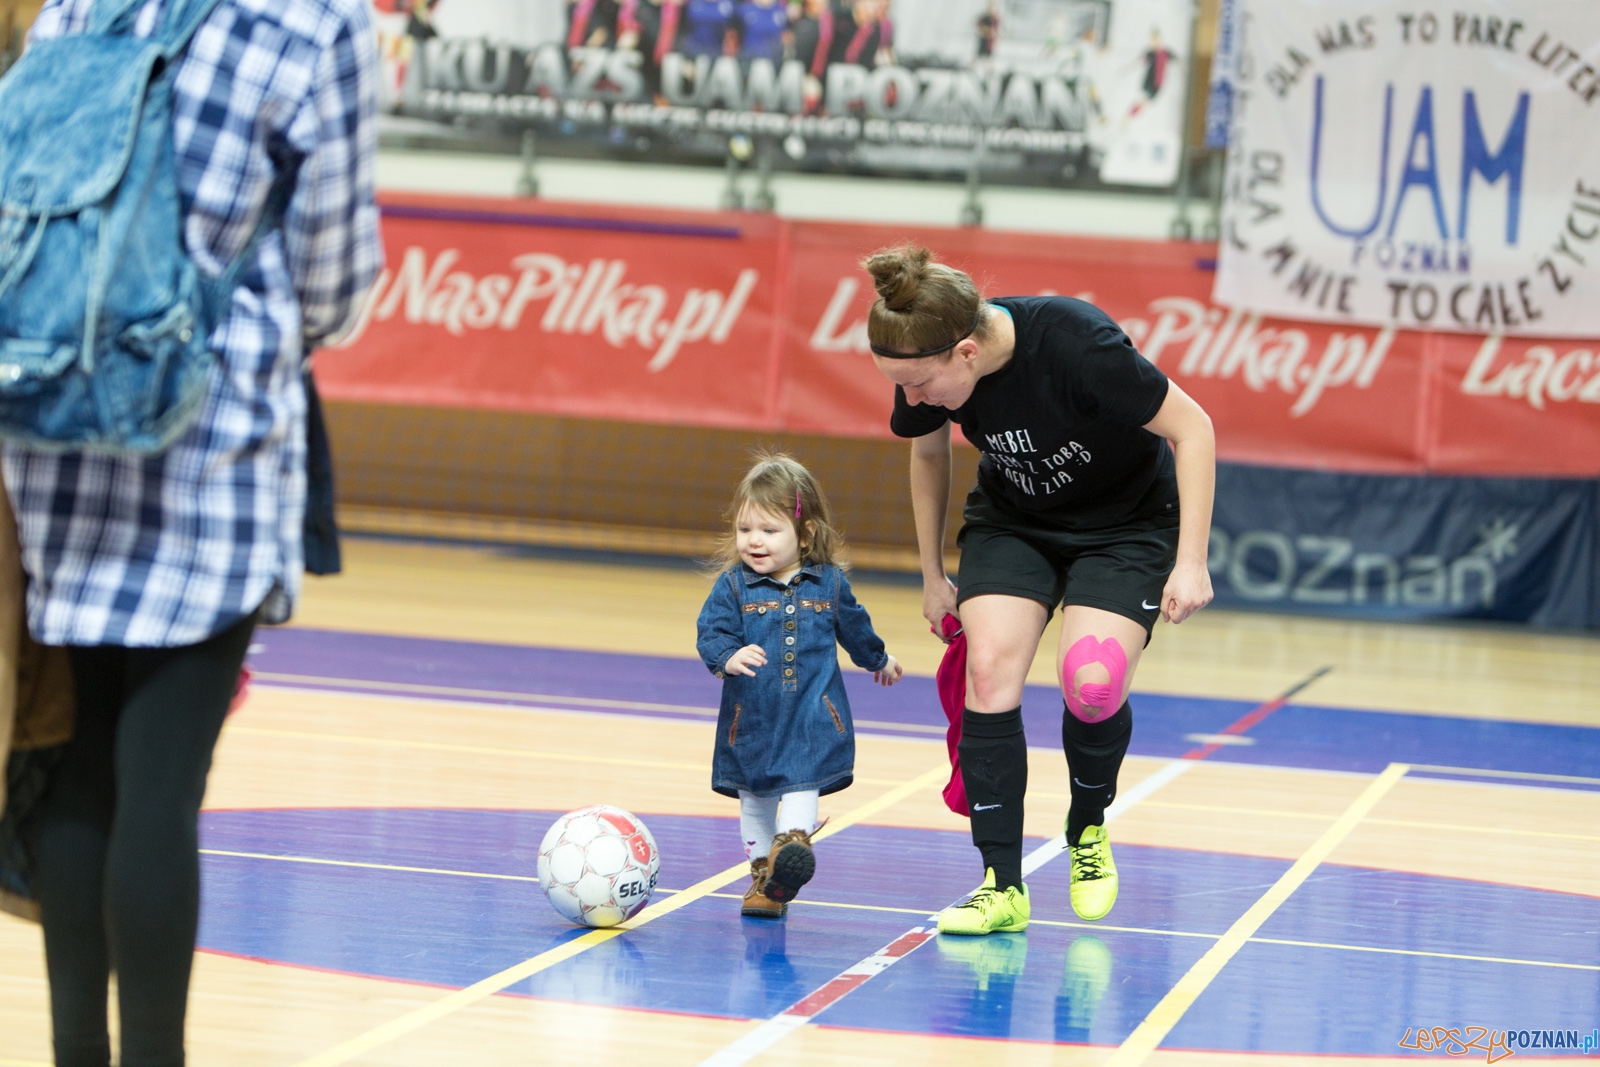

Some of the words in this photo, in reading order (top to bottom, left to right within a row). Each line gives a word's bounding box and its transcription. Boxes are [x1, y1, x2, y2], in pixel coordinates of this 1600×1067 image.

[1397, 11, 1438, 44] TO
[524, 43, 645, 100] AZS
[660, 51, 804, 115] UAM
[1310, 74, 1531, 246] UAM
[1385, 278, 1439, 323] TO
[984, 428, 1038, 454] MEBEL
